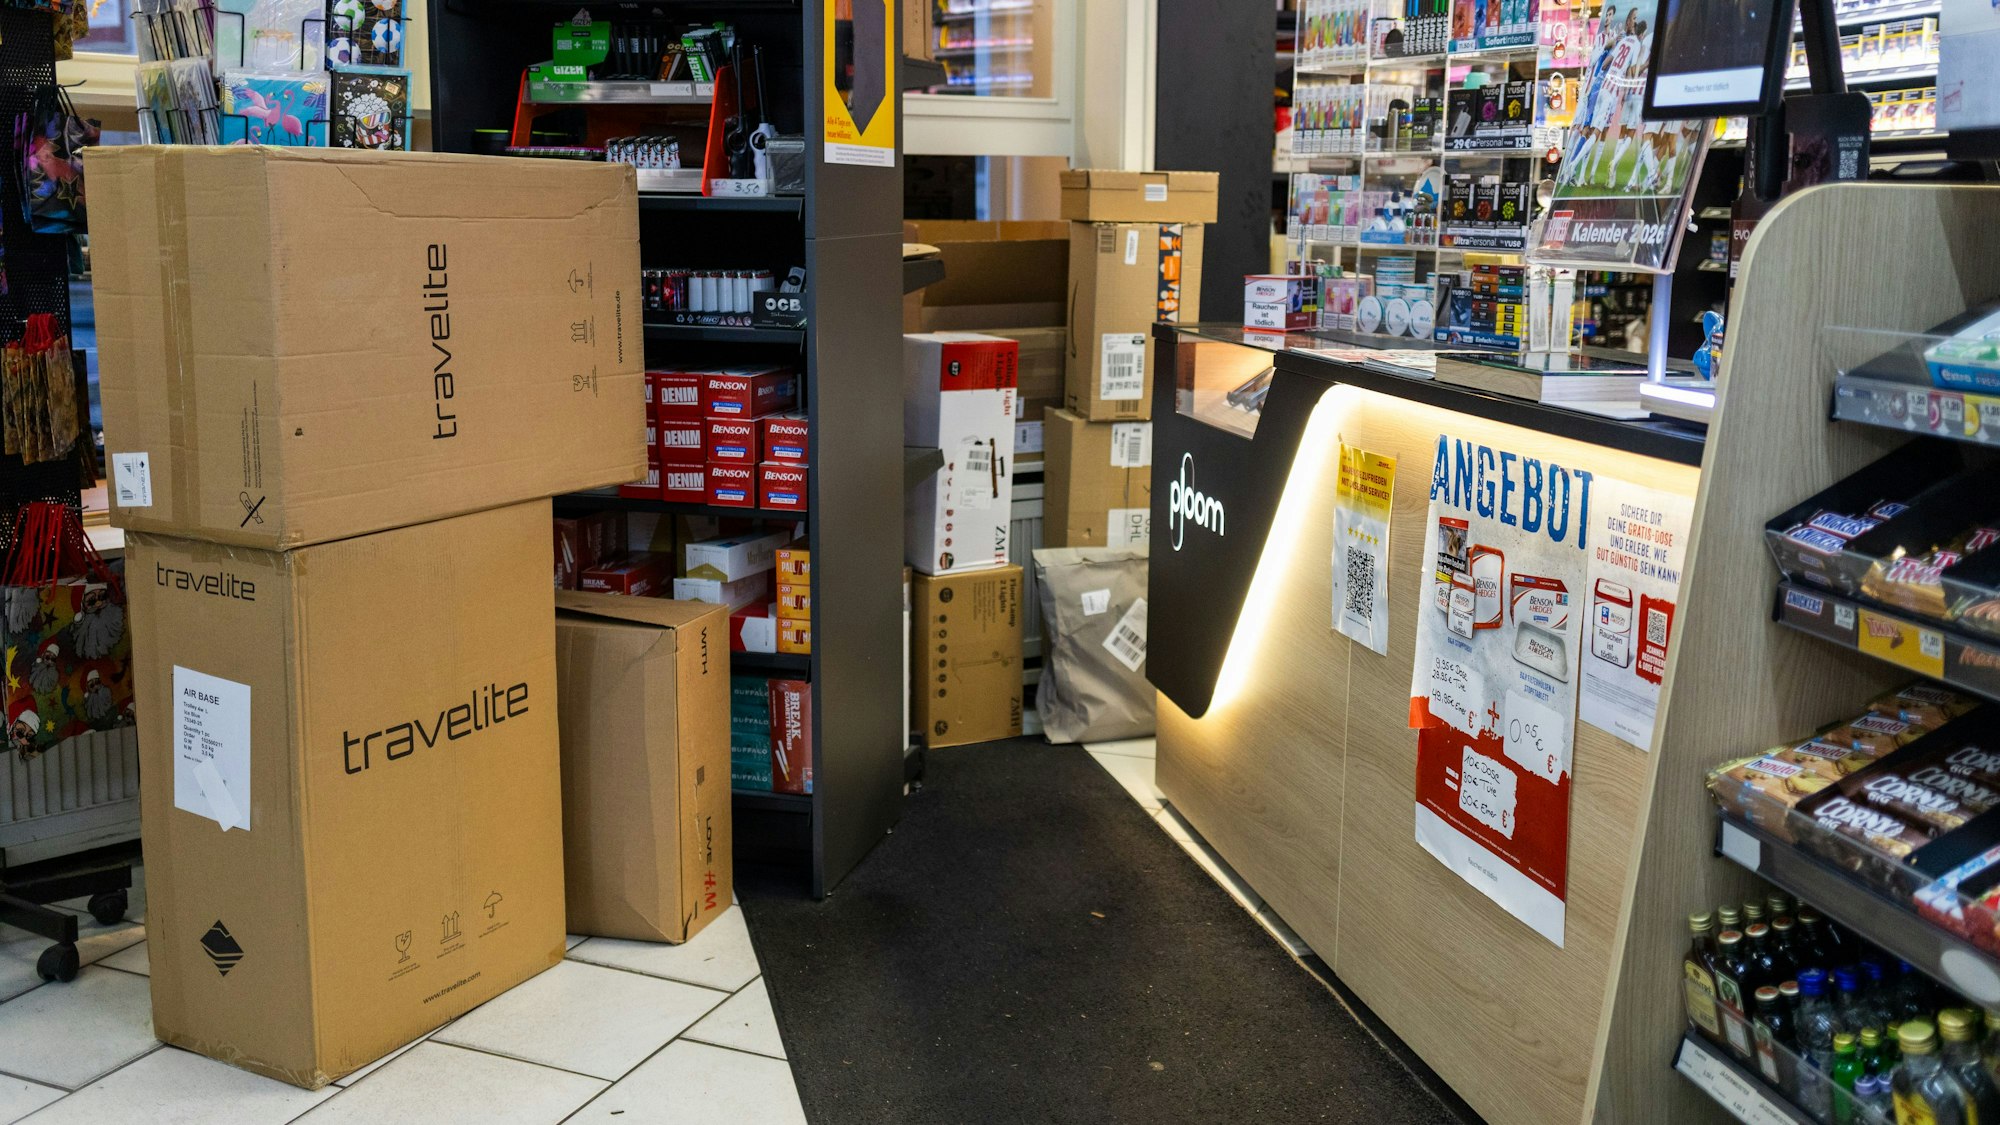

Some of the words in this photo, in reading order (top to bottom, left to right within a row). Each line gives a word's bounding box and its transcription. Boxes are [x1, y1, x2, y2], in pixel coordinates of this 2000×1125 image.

[554, 66, 584, 75] GIZEH
[1571, 222, 1628, 243] Kalender
[1629, 223, 1666, 244] 2026
[1733, 228, 1750, 240] evo
[765, 297, 801, 311] OCB
[614, 290, 624, 364] www.travelite.de
[422, 243, 458, 440] travelite
[709, 380, 747, 390] BENSON
[662, 386, 698, 402] DENIM
[1004, 390, 1012, 416] Light
[664, 430, 700, 445] DENIM
[712, 424, 750, 435] BENSON
[770, 424, 808, 435] BENSON
[668, 472, 704, 488] DENIM
[712, 468, 750, 479] BENSON
[764, 471, 803, 481] BENSON
[1362, 472, 1388, 486] ZUFRIEDEN
[1369, 486, 1390, 501] SERVICE?
[1430, 434, 1593, 550] ANGEBOT
[1170, 452, 1224, 552] ploom
[1621, 504, 1648, 522] SICHERE
[1650, 511, 1662, 527] DIR
[1130, 514, 1143, 542] DHL
[1608, 516, 1627, 534] DEINE
[1628, 522, 1673, 547] GRATIS-DOSE
[994, 526, 1006, 564] ZMH
[1610, 534, 1624, 550] UND
[1625, 539, 1651, 559] ERLEBE,
[1654, 547, 1667, 563] WIE
[781, 562, 797, 573] PALL
[1597, 547, 1609, 562] GUT
[1611, 550, 1638, 572] GÜNSTIG
[1640, 560, 1656, 577] SEIN
[1658, 567, 1680, 584] KANN!
[156, 562, 256, 602] travelite
[1476, 579, 1497, 590] BENSON
[782, 596, 797, 607] PALL
[1529, 596, 1554, 606] BENSON
[1008, 603, 1017, 628] Lamp
[1452, 608, 1469, 622] Rauchen
[783, 631, 797, 642] PALL
[1599, 629, 1623, 645] Rauchen
[1530, 639, 1554, 655] BENSON
[1606, 643, 1614, 651] ist
[1600, 650, 1619, 663] tödlich
[184, 688, 196, 699] AIR
[198, 692, 220, 706] BASE
[734, 688, 770, 697] BUFFALO
[790, 692, 801, 739] BREAK
[1011, 696, 1020, 727] ZMH
[342, 681, 529, 775] travelite
[734, 717, 769, 725] BUFFALO
[184, 724, 200, 736] Quantity
[732, 746, 768, 755] BUFFALO
[1464, 754, 1479, 770] 10€
[1750, 758, 1797, 777] hanuta
[1946, 747, 2000, 774] COR
[732, 774, 768, 782] BUFFALO
[1463, 771, 1478, 787] 30€
[1461, 790, 1479, 809] 50€
[1864, 774, 1950, 813] CORNY
[1867, 791, 1892, 804] BIG
[1813, 798, 1900, 837] CORNY
[422, 971, 482, 1004] www.travelite.com
